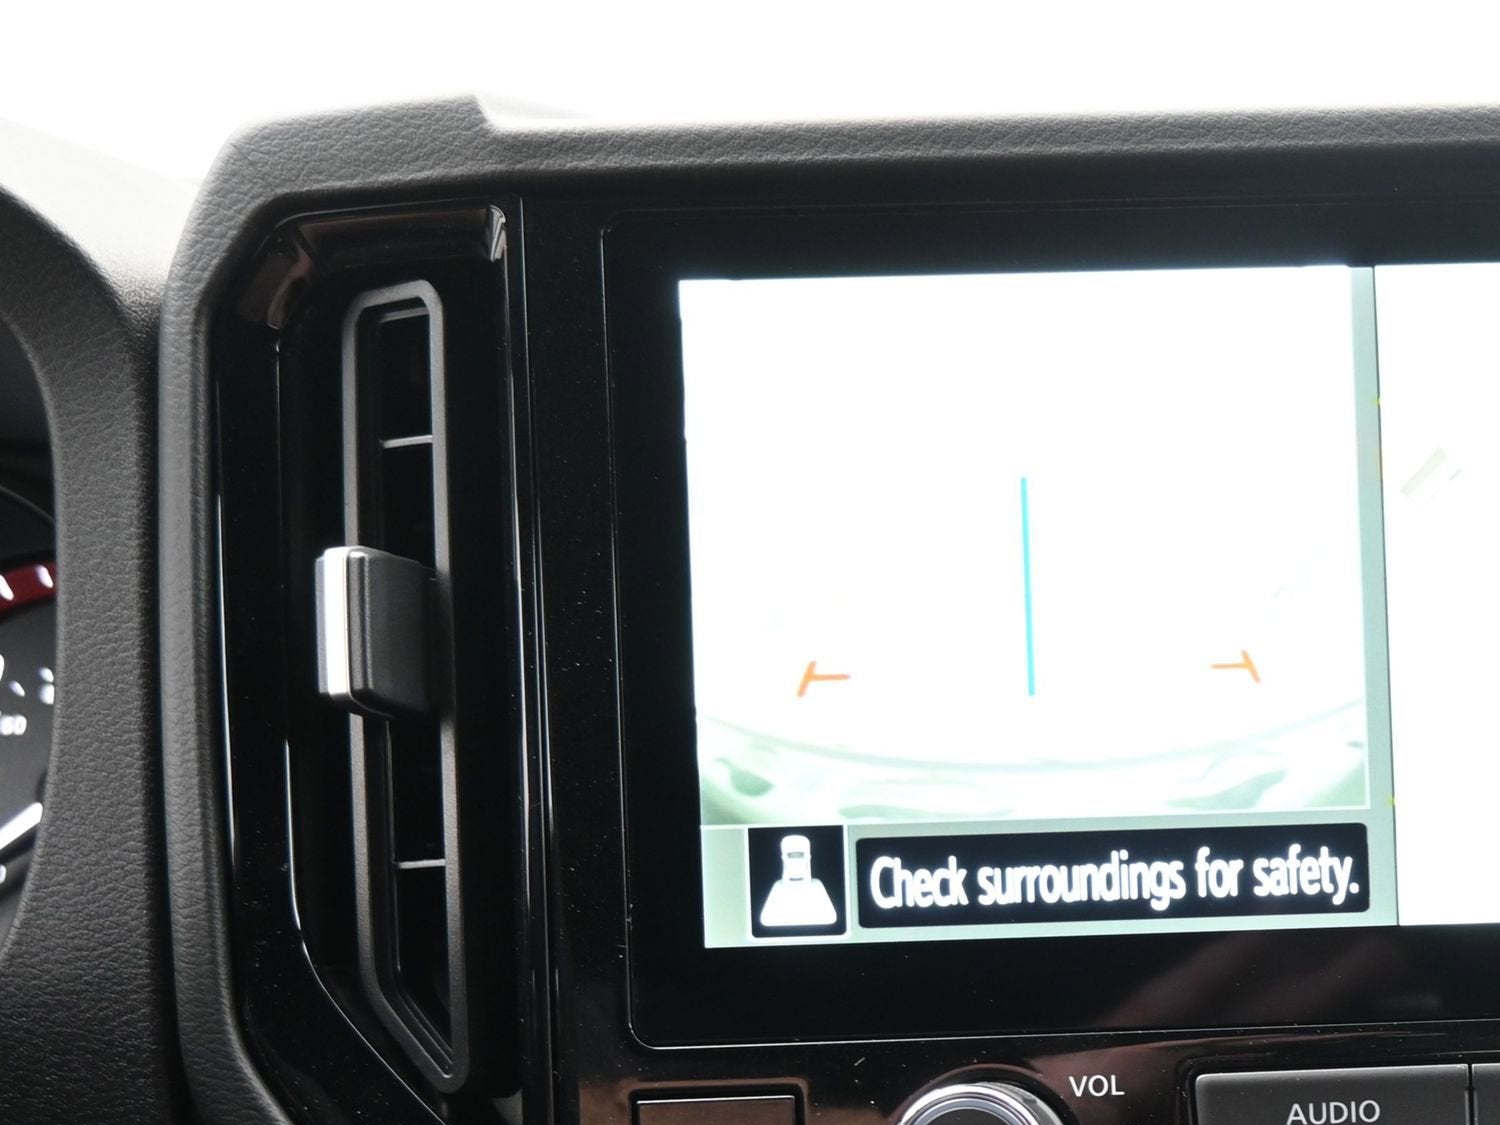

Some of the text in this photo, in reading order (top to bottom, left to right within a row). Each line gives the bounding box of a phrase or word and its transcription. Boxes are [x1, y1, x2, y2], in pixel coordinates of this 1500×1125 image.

[869, 843, 1360, 911] Check surroundings for safety.
[1068, 1074, 1125, 1098] VOL
[1286, 1100, 1381, 1125] AUDIO
